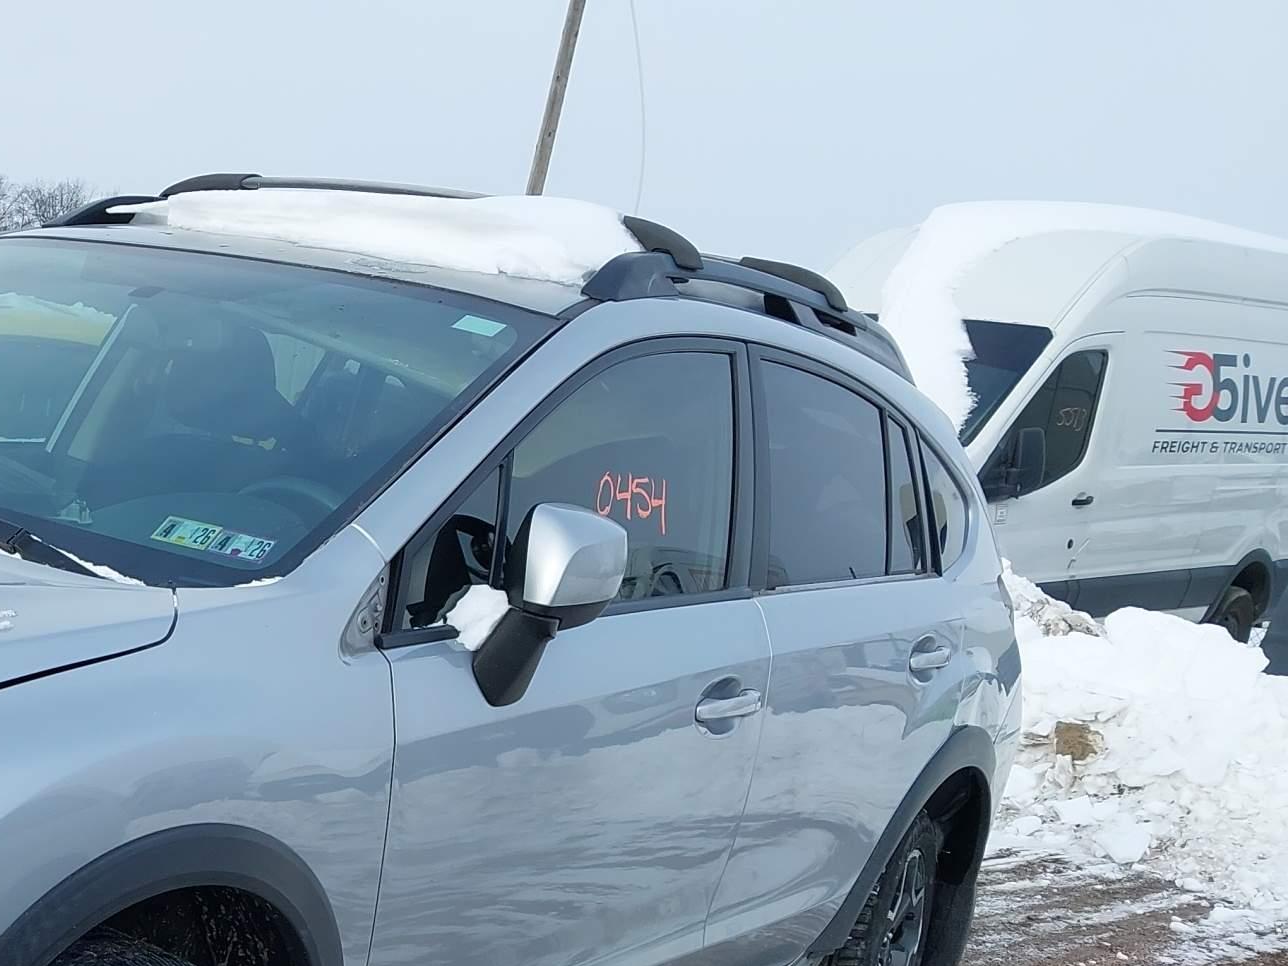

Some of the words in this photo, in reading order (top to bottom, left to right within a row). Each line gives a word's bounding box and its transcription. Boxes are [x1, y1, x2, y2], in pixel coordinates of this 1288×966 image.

[1152, 440, 1208, 453] FREIGHT
[1209, 441, 1220, 453] &
[1223, 441, 1288, 455] TRANSPORT
[597, 471, 667, 535] 0454
[193, 527, 217, 545] 26
[248, 540, 272, 559] 26
